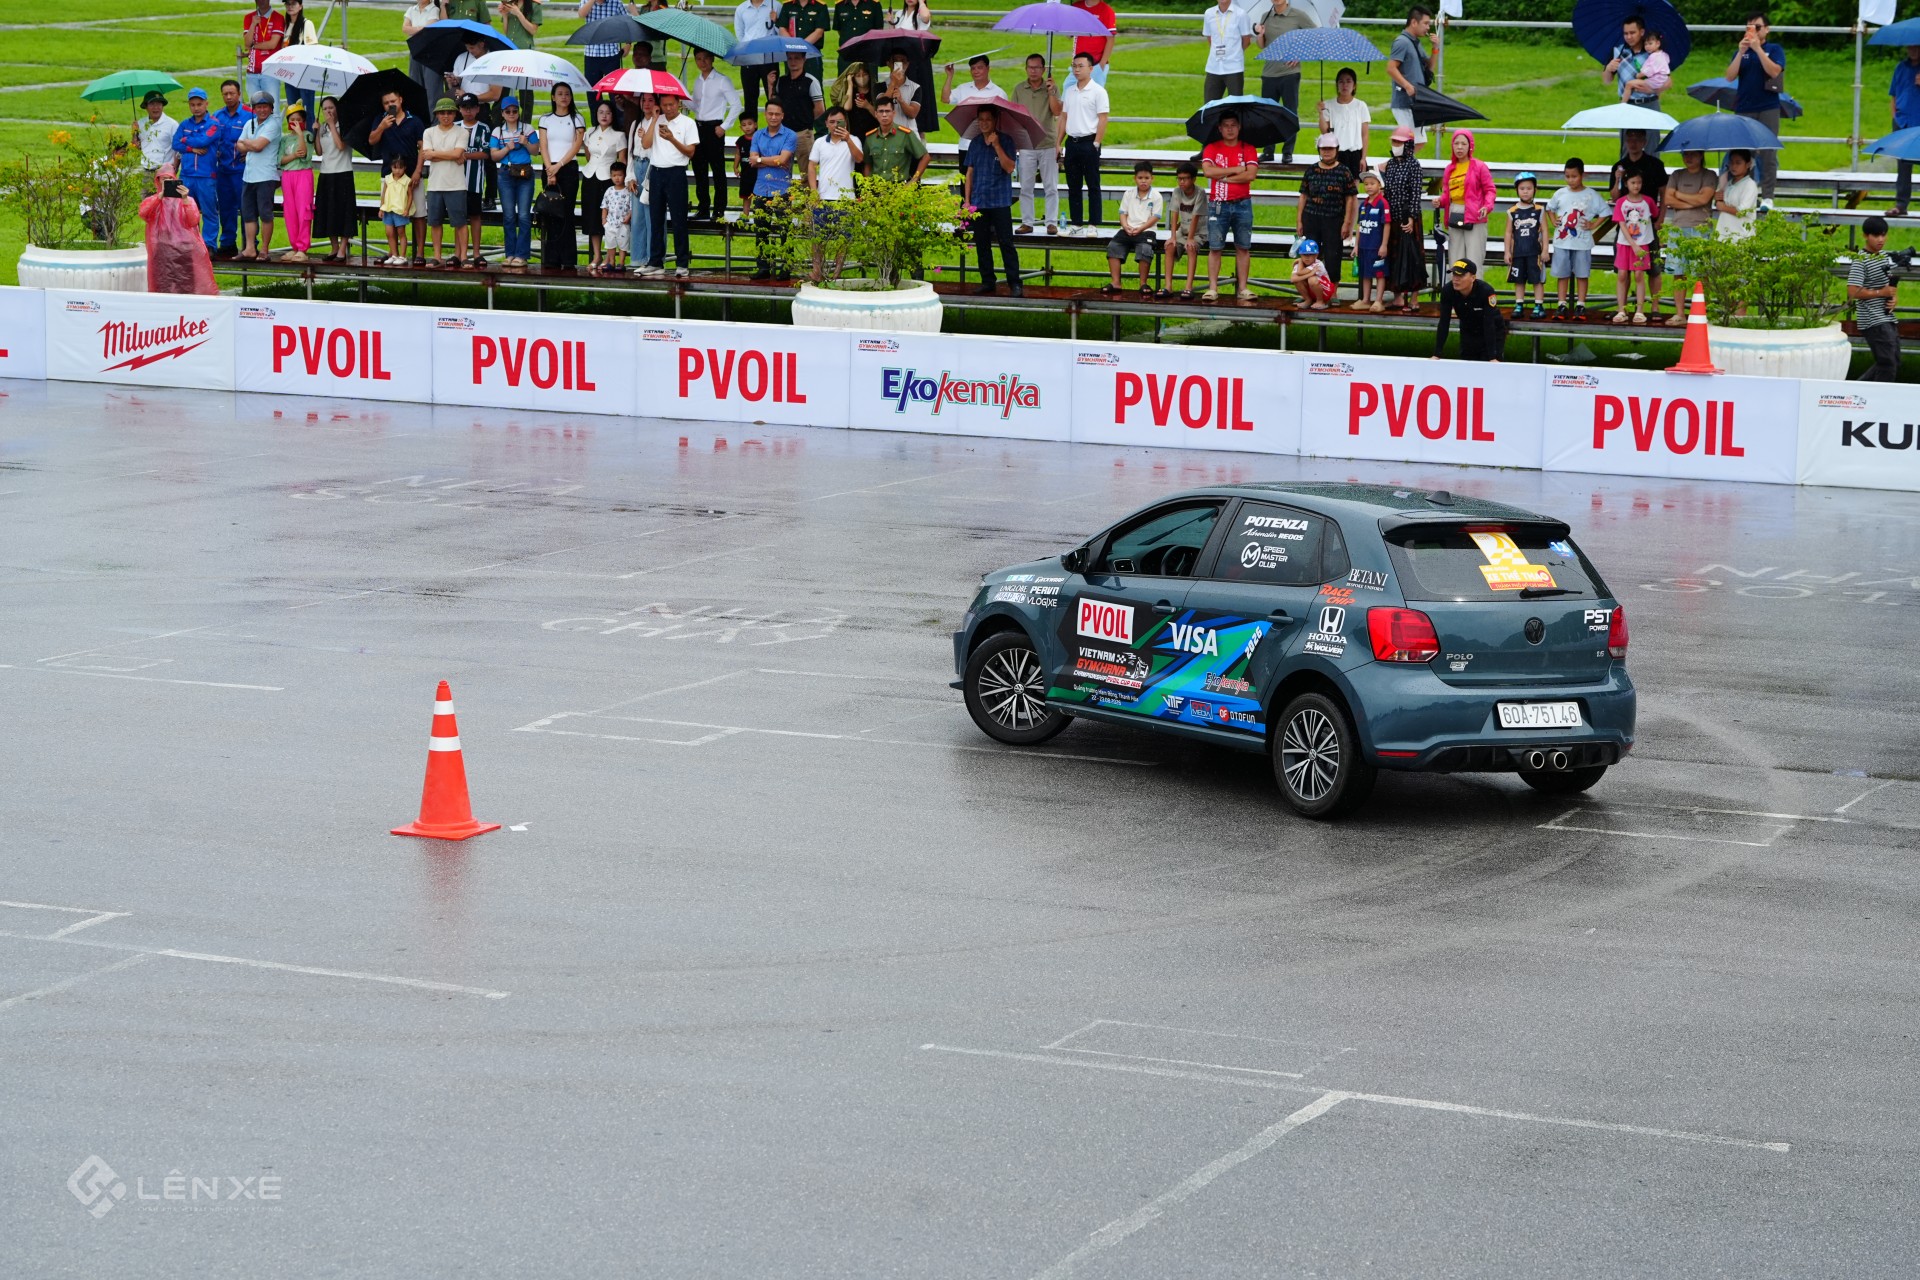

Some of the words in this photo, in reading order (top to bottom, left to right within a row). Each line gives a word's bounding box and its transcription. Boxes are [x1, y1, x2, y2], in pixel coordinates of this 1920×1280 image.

[501, 65, 524, 74] PVOIL
[1520, 228, 1530, 237] 23
[96, 315, 210, 359] Milwaukee
[273, 325, 391, 380] PVOIL
[472, 336, 596, 391] PVOIL
[679, 348, 807, 404] PVOIL
[881, 367, 1041, 420] Ekokemika
[1115, 372, 1254, 431] PVOIL
[1348, 382, 1495, 442] PVOIL
[1592, 395, 1745, 457] PVOIL
[1841, 420, 1920, 451] KU
[1244, 515, 1309, 531] POTENZA
[1260, 553, 1288, 562] MASTER
[1263, 545, 1286, 554] SPEED
[1258, 561, 1277, 569] CLUB
[1348, 568, 1389, 587] BETANI
[1486, 573, 1500, 581] XE
[1319, 583, 1355, 597] RACE
[1326, 596, 1357, 605] CHIP
[1081, 602, 1128, 640] PVOIL
[1583, 609, 1612, 624] PST
[1167, 621, 1218, 657] VISA
[1244, 625, 1263, 660] 2026
[1307, 632, 1348, 644] HONDA
[1079, 646, 1116, 663] VIETNAM
[1073, 669, 1107, 682] CHAMPIONSHIP
[1076, 658, 1127, 677] GYMKHANA
[1229, 711, 1256, 724] OTOFUN
[1502, 705, 1577, 725] 60A-751.46
